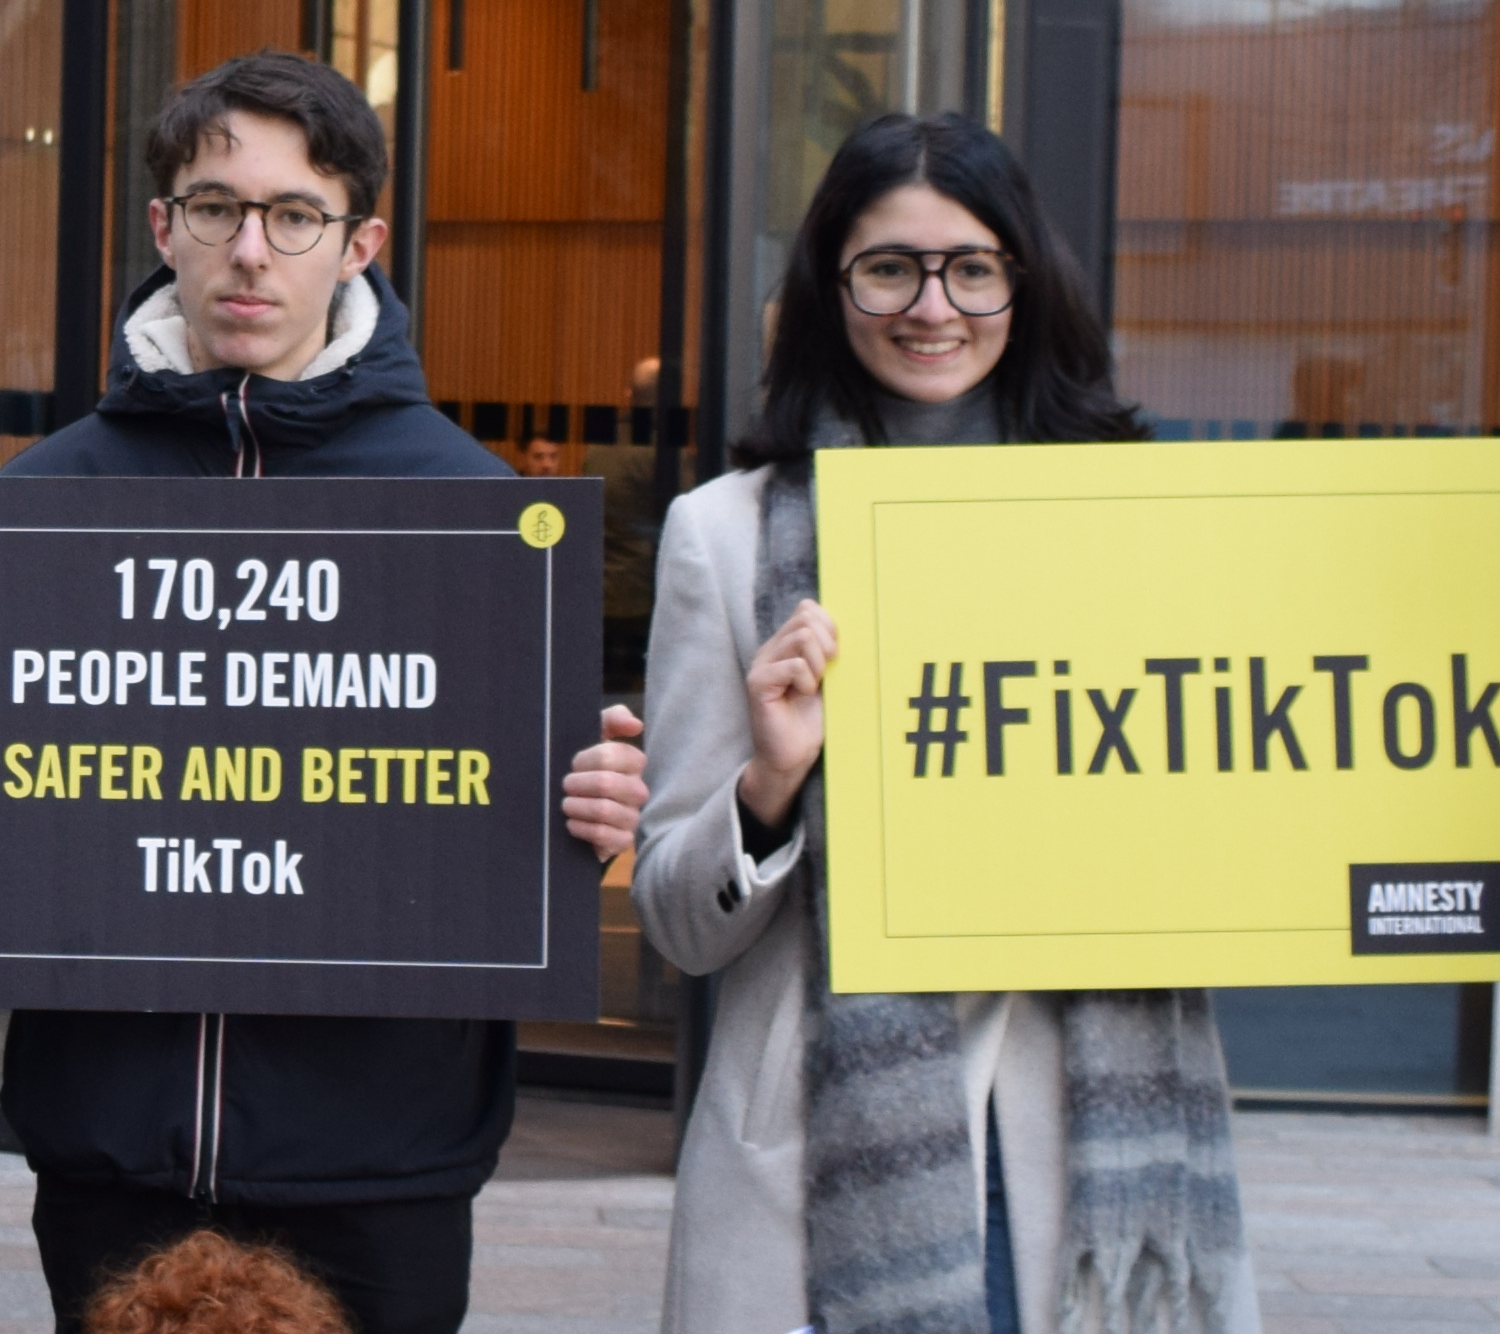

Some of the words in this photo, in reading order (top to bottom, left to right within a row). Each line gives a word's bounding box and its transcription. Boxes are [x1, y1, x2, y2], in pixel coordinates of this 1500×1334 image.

[114, 557, 340, 631] 170,240
[12, 649, 207, 706] PEOPLE
[226, 652, 437, 709] DEMAND
[3, 743, 163, 800] SAFER
[180, 746, 282, 802] AND
[302, 747, 490, 805] BETTER
[137, 837, 304, 895] TikTok
[1368, 881, 1484, 913] AMNESTY
[1368, 915, 1484, 935] INTERNATIONAL
